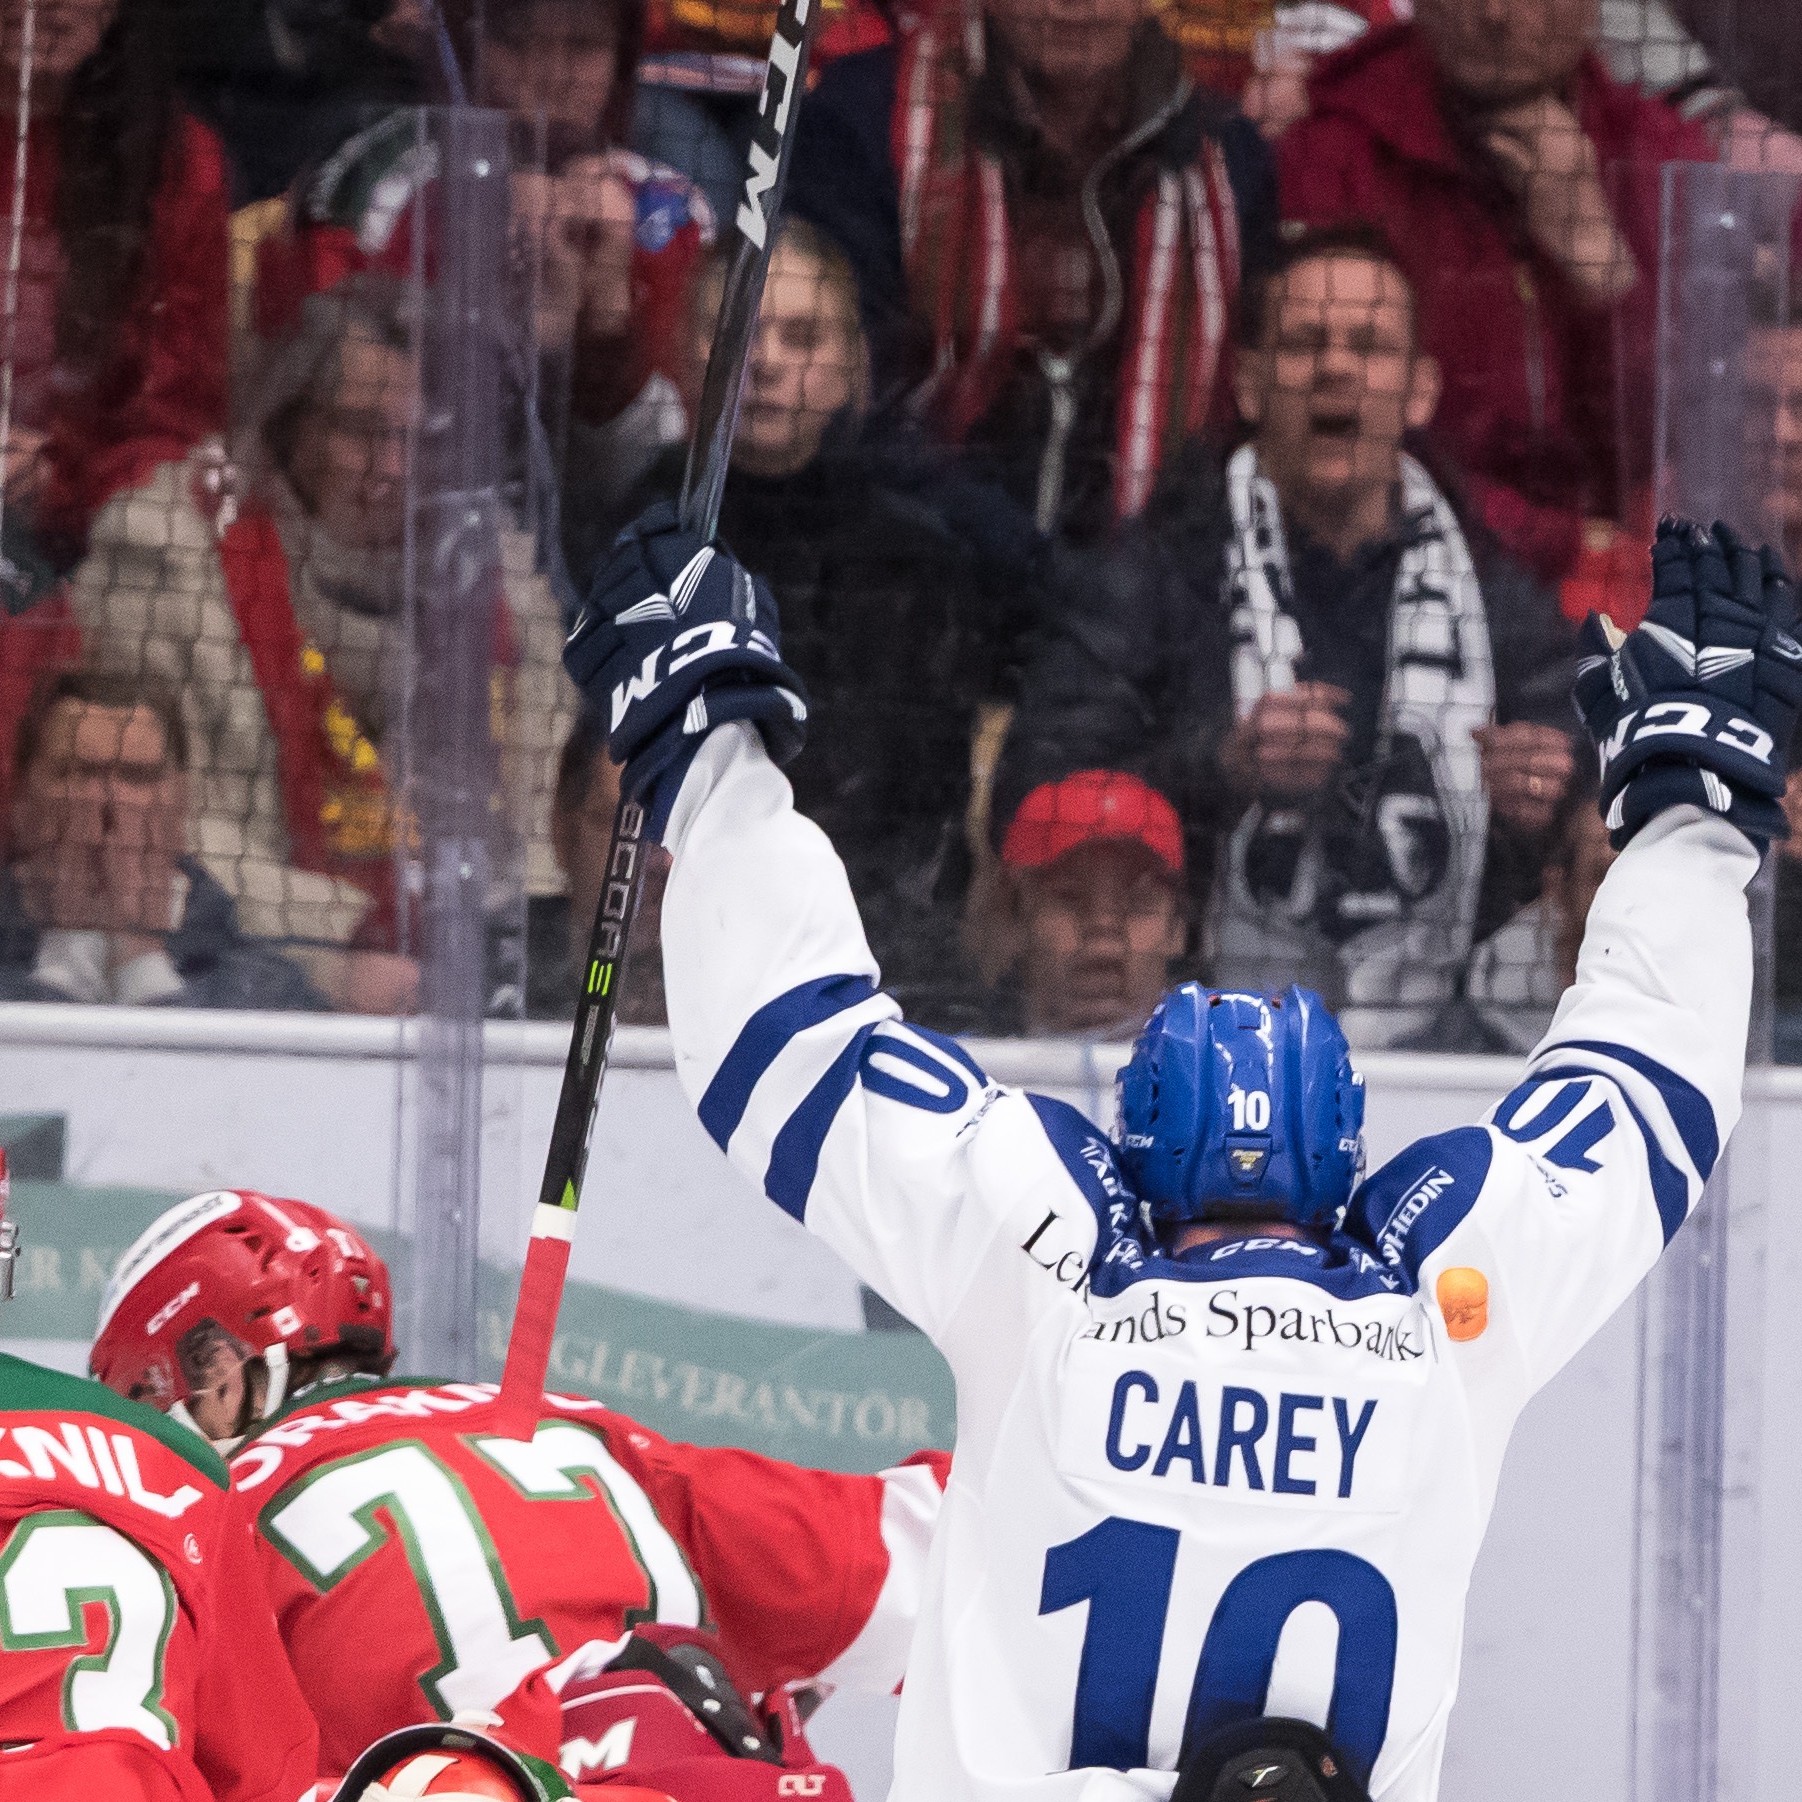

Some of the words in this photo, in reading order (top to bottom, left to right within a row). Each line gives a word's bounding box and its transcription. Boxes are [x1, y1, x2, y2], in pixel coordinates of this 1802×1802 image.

[1227, 1089, 1271, 1132] 10
[1105, 1368, 1379, 1500] CAREY
[258, 1418, 718, 1723] 77
[1038, 1514, 1400, 1783] 10
